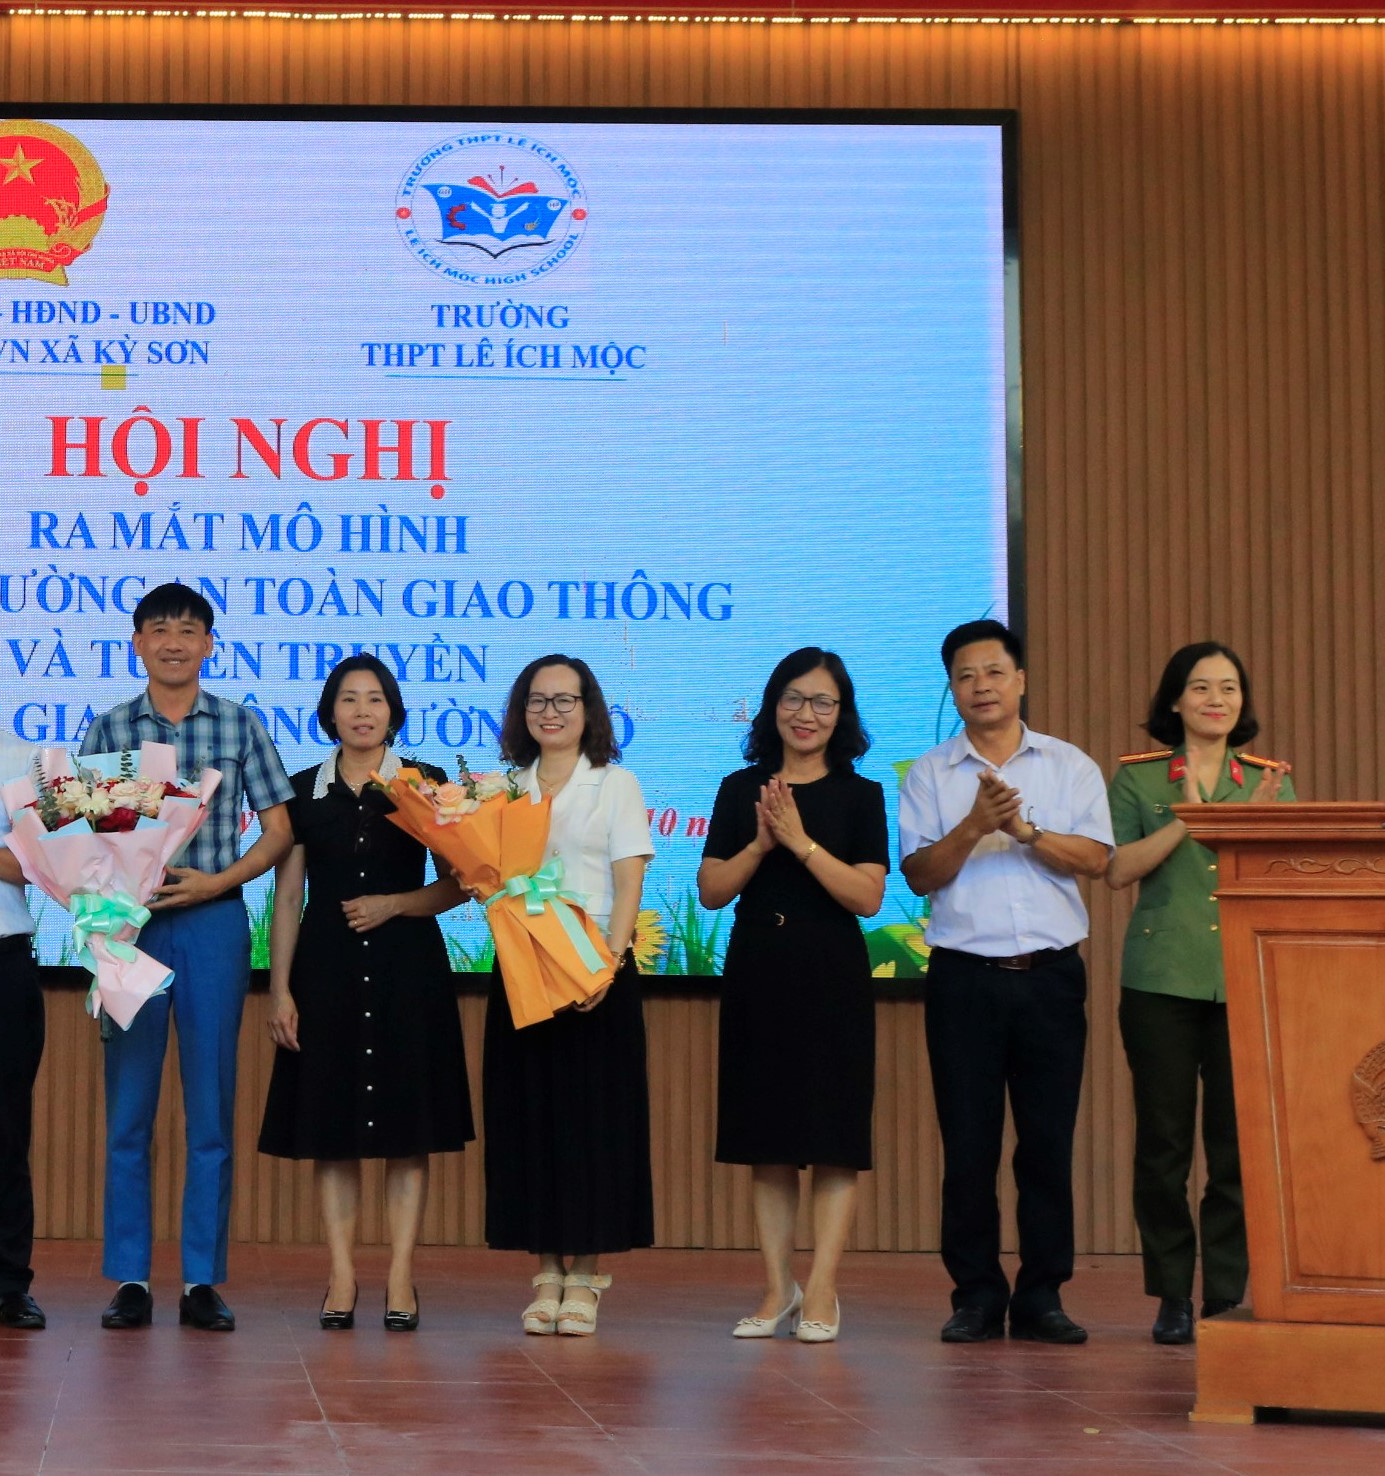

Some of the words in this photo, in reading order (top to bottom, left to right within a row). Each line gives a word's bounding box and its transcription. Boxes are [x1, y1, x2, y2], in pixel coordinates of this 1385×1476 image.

[457, 135, 503, 147] THPT
[484, 273, 527, 285] HIGH
[530, 233, 579, 277] SCHOOL
[11, 300, 102, 324] HĐND
[129, 301, 216, 325] UBND
[430, 299, 569, 329] TRƯỜNG
[40, 334, 83, 364] XÃ
[94, 334, 139, 364] KỲ
[147, 339, 211, 365] SƠN
[361, 342, 446, 367] THPT
[454, 337, 495, 368] LÊ
[504, 338, 561, 369] ÍCH
[570, 341, 647, 376] MỘC
[44, 405, 207, 497] HỘI
[228, 417, 455, 500] NGHỊ
[28, 510, 97, 550] RA
[110, 502, 225, 552] MẮT
[239, 501, 323, 553] MÔ
[339, 503, 470, 555] HÌNH
[244, 567, 387, 618] TOÀN
[402, 578, 534, 619] GIAO
[547, 568, 734, 622] THÔNG
[6, 627, 76, 678] VÀ
[13, 702, 98, 742] GIA
